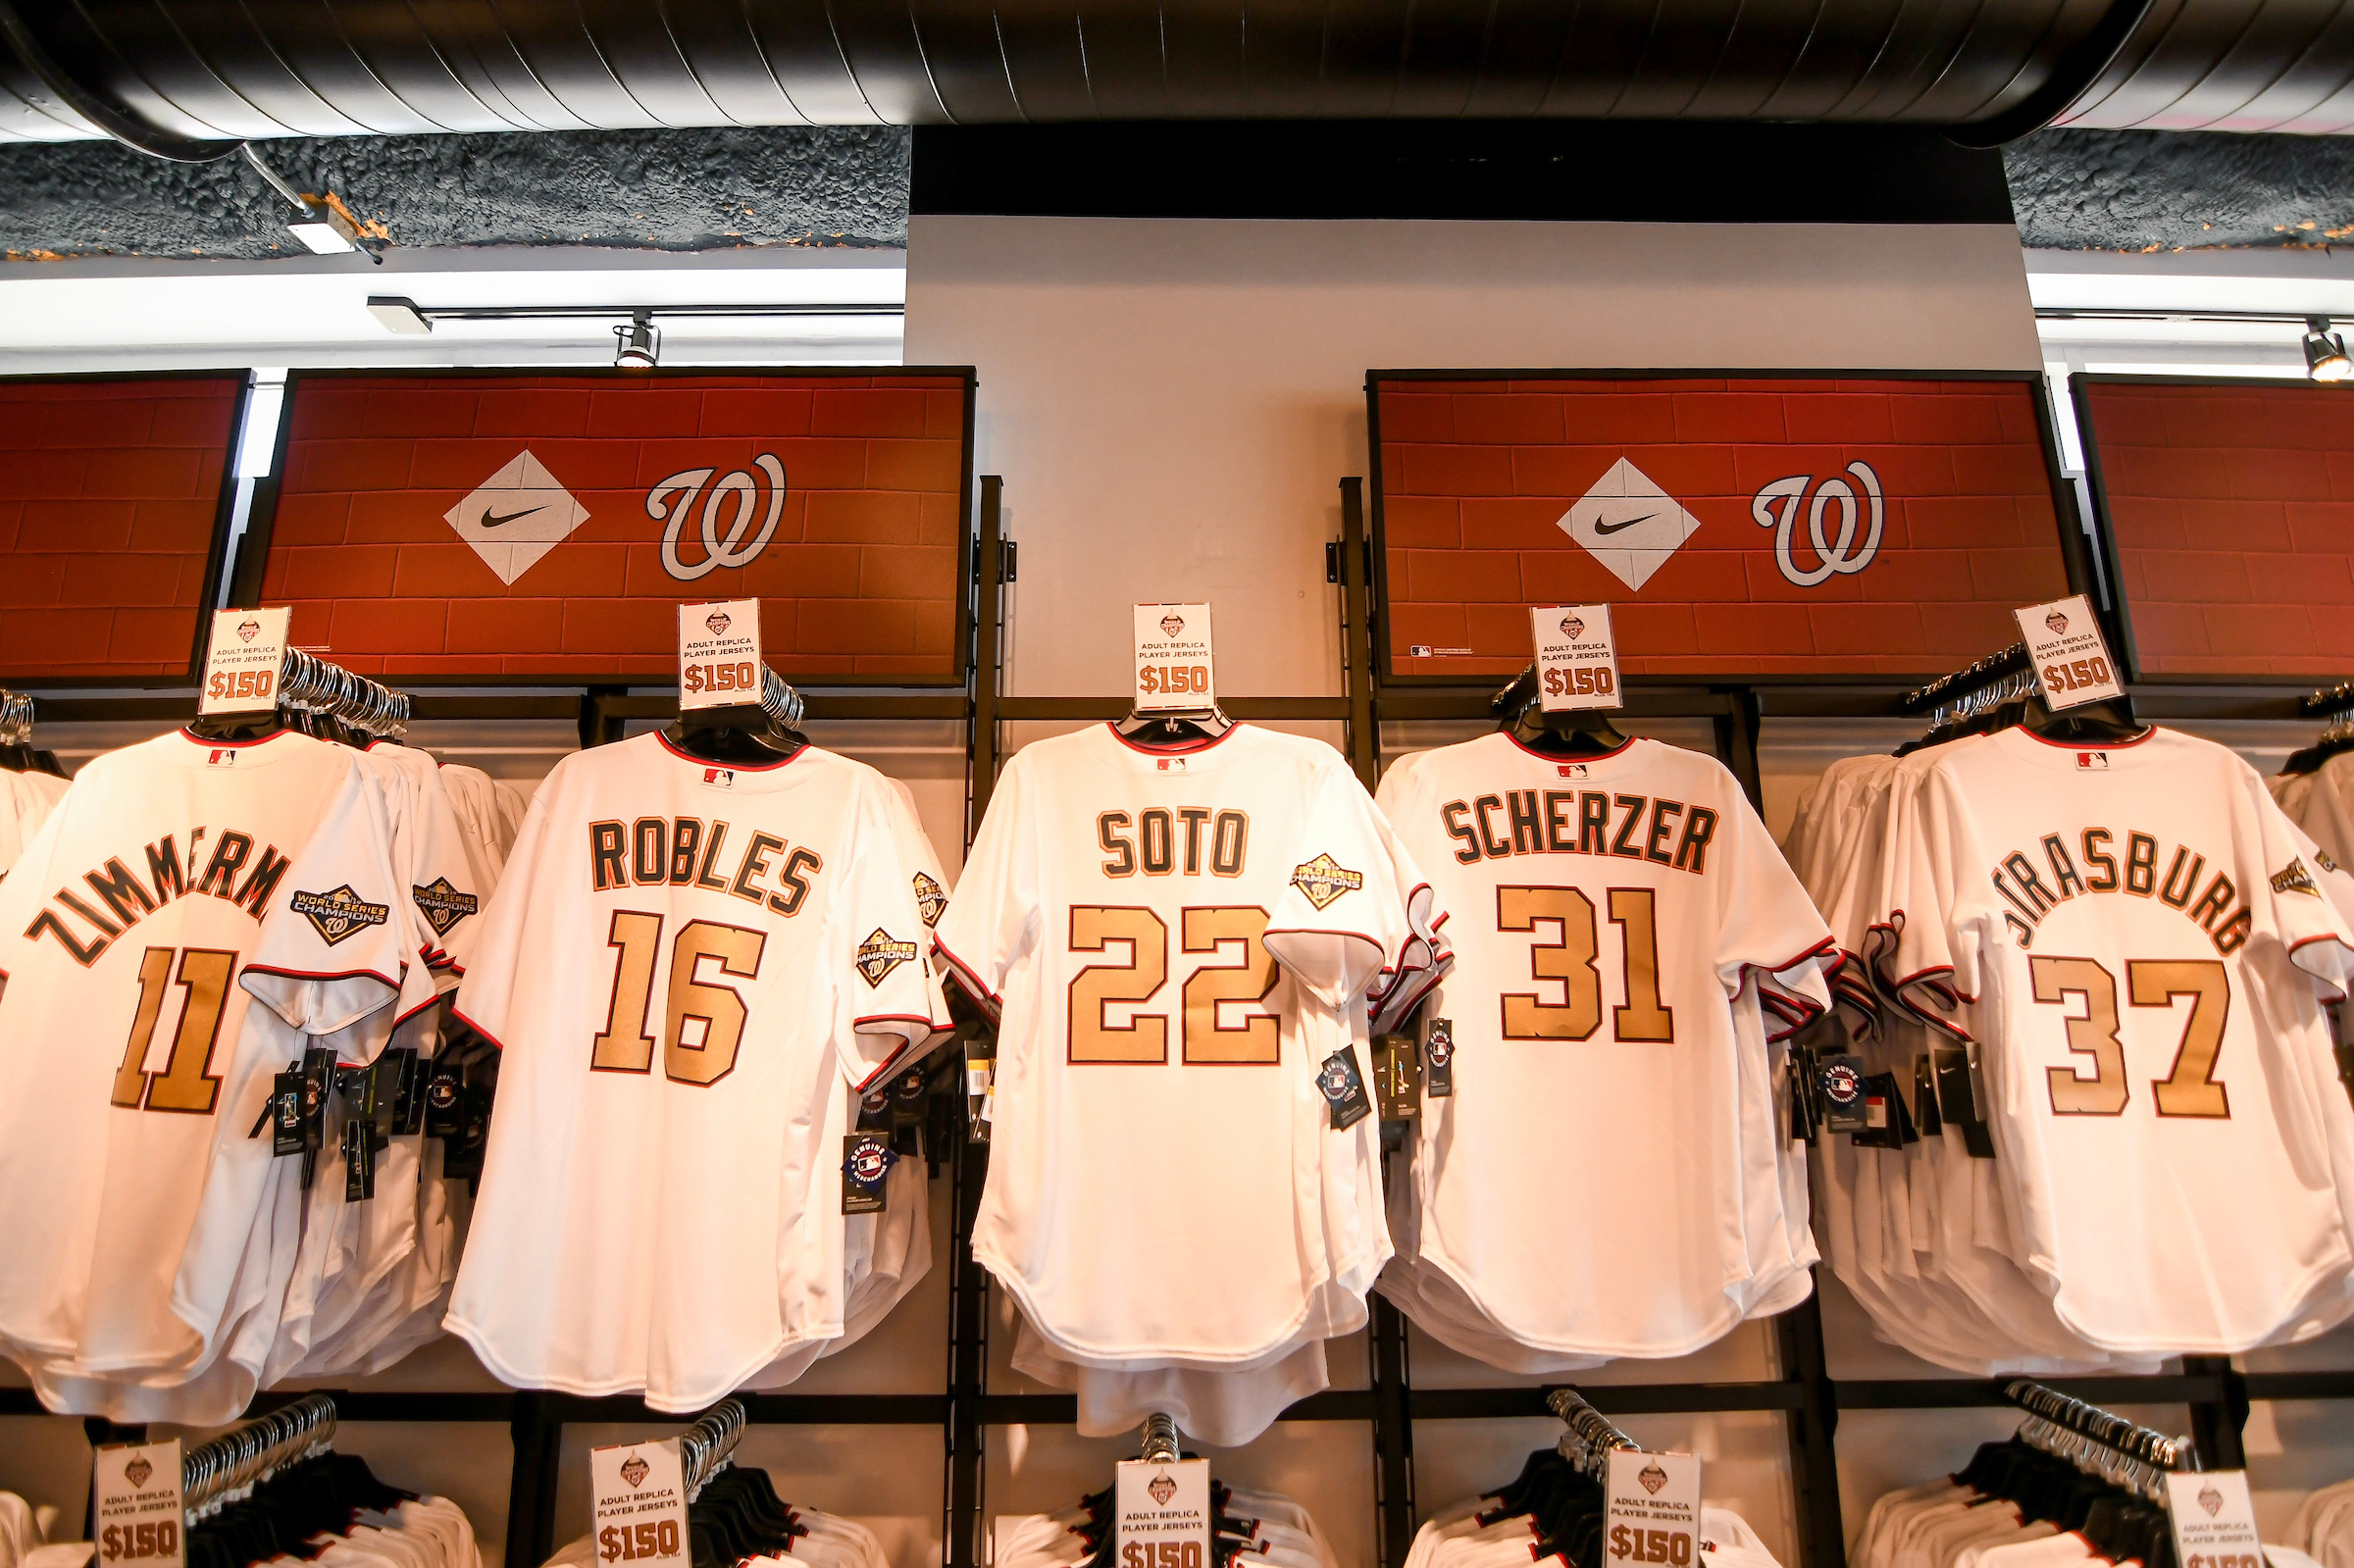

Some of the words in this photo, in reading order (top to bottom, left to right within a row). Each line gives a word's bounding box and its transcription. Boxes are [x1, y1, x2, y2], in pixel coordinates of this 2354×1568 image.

[646, 451, 787, 582] W
[1751, 460, 1885, 586] W
[684, 649, 716, 658] PLAYER
[718, 646, 754, 655] JERSEYS
[687, 640, 714, 649] ADULT
[716, 637, 751, 646] REPLICA
[2035, 640, 2060, 651] ADULT
[2062, 633, 2094, 645] REPLICA
[2036, 649, 2066, 661] PLAYER
[2068, 641, 2100, 654] JERSEYS
[207, 670, 274, 700] $150
[684, 661, 754, 694] $150
[1139, 665, 1208, 695] $150
[1544, 667, 1613, 697] $150
[2043, 656, 2111, 694] $150
[1097, 806, 1250, 879] SOTO
[1440, 789, 1719, 875] SCHERZER
[588, 816, 823, 918] ROBLES
[297, 894, 340, 909] WORLD
[343, 903, 386, 915] SERIES
[415, 888, 441, 900] WORLD
[444, 894, 476, 904] SERIES
[415, 894, 475, 912] CHAMPIONS
[294, 901, 384, 923] CHAMPIONS
[433, 908, 449, 925] W
[325, 917, 349, 934] W
[879, 943, 915, 952] SERIES
[1496, 885, 1674, 1044] 31
[1066, 904, 1281, 1066] 22
[589, 909, 768, 1087] 16
[111, 945, 239, 1116] 11
[2026, 954, 2231, 1120] 37
[1825, 1065, 1860, 1081] GENUINE
[850, 1143, 886, 1161] GENUINE
[853, 1164, 888, 1182] MERCHANDISE
[105, 1494, 132, 1505] ADULT
[136, 1490, 175, 1501] REPLICA
[600, 1494, 632, 1506] ADULT
[634, 1488, 675, 1501] REPLICA
[1614, 1497, 1646, 1507] ADULT
[1649, 1500, 1690, 1510] REPLICA
[102, 1506, 136, 1516] PLAYER
[138, 1500, 178, 1513] JERSEYS
[597, 1506, 634, 1518] PLAYER
[637, 1499, 678, 1513] JERSEYS
[1125, 1512, 1156, 1521] ADULT
[1159, 1510, 1200, 1519] REPLICA
[1611, 1508, 1648, 1518] PLAYER
[1651, 1511, 1693, 1522] JERSEYS
[1122, 1523, 1158, 1533] PLAYER
[1161, 1521, 1203, 1530] JERSEYS
[102, 1520, 178, 1562] $150
[599, 1519, 680, 1563] $150
[1609, 1524, 1691, 1566] $150
[1122, 1540, 1202, 1568] $150
